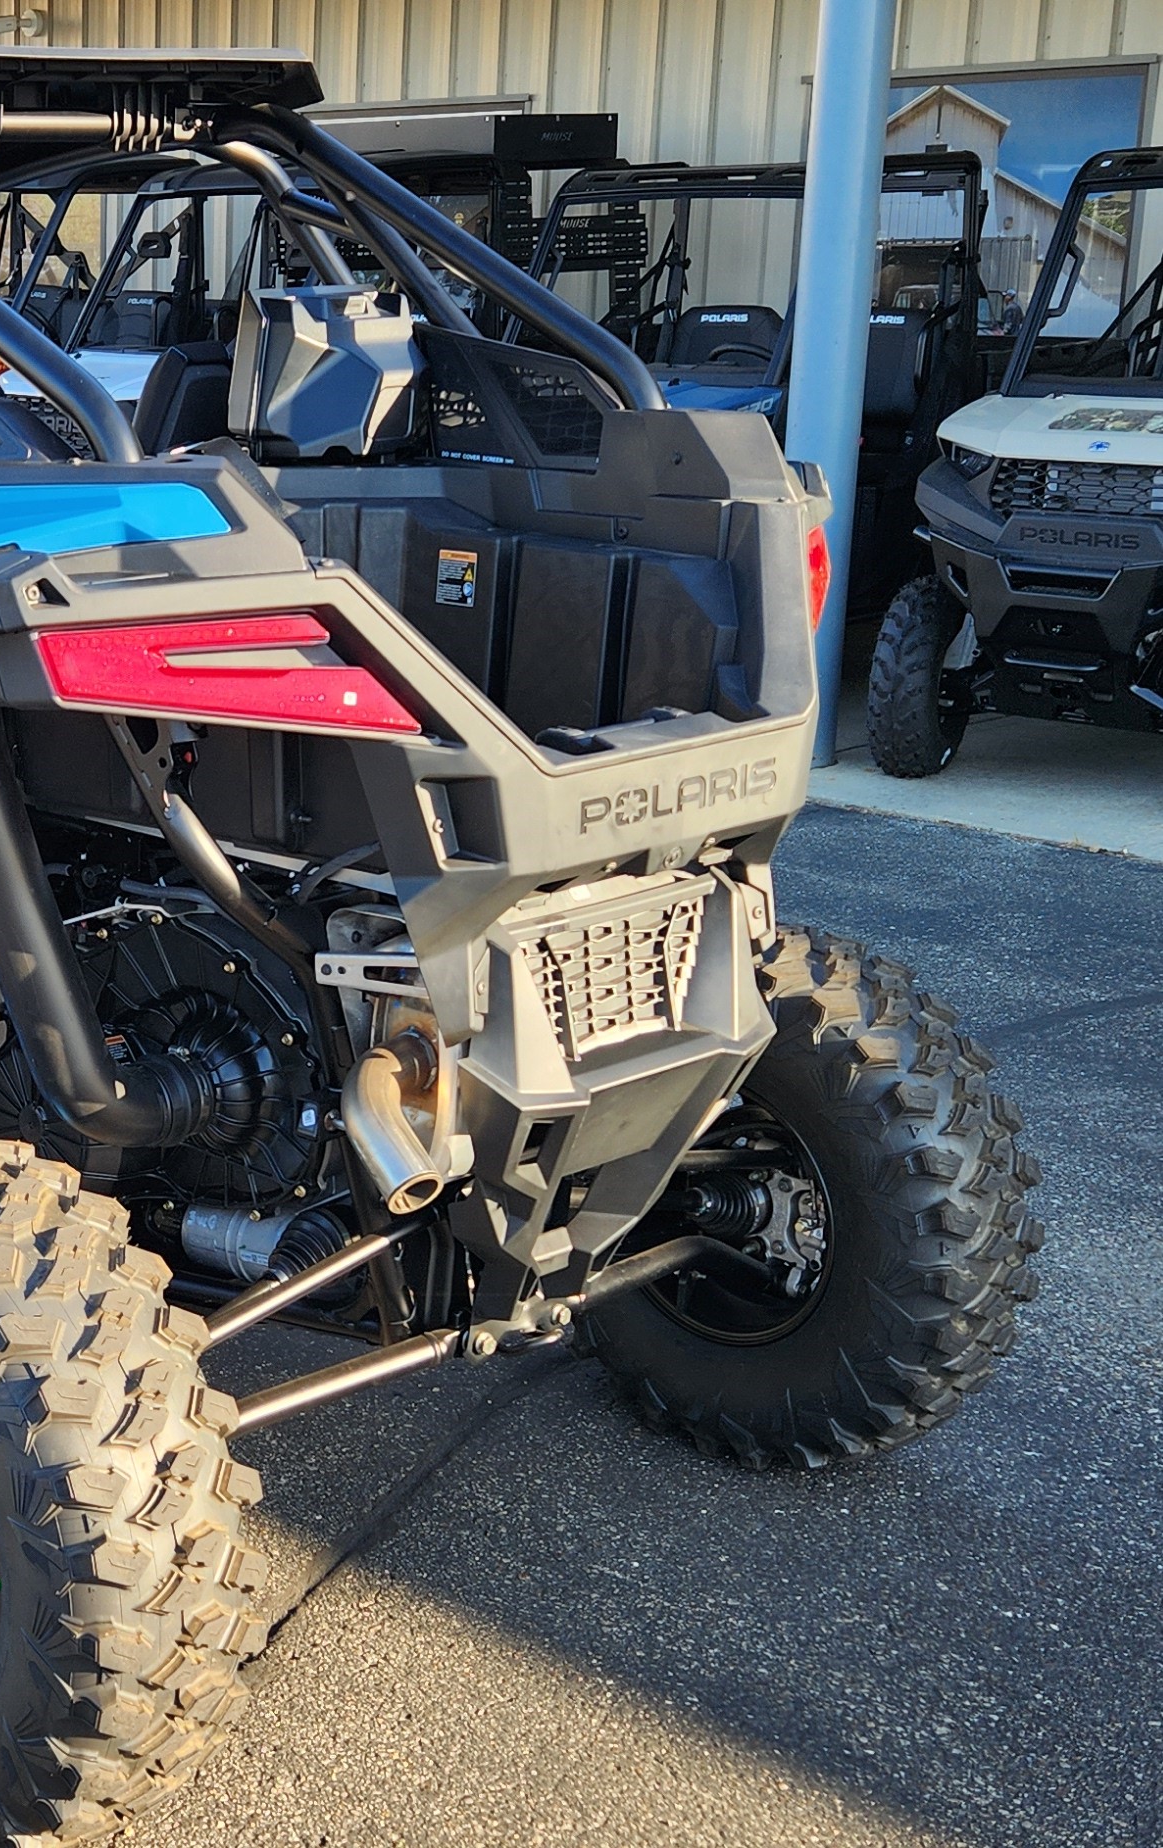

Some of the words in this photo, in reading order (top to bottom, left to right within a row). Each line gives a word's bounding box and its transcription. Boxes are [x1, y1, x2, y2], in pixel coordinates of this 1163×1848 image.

[560, 218, 591, 228] MOOSE
[127, 297, 154, 305] POLARIS
[699, 313, 748, 323] POLARIS
[462, 453, 481, 461] COVER
[482, 455, 504, 464] SCREEN
[1019, 527, 1140, 550] POLARIS
[579, 757, 777, 835] POLARIS
